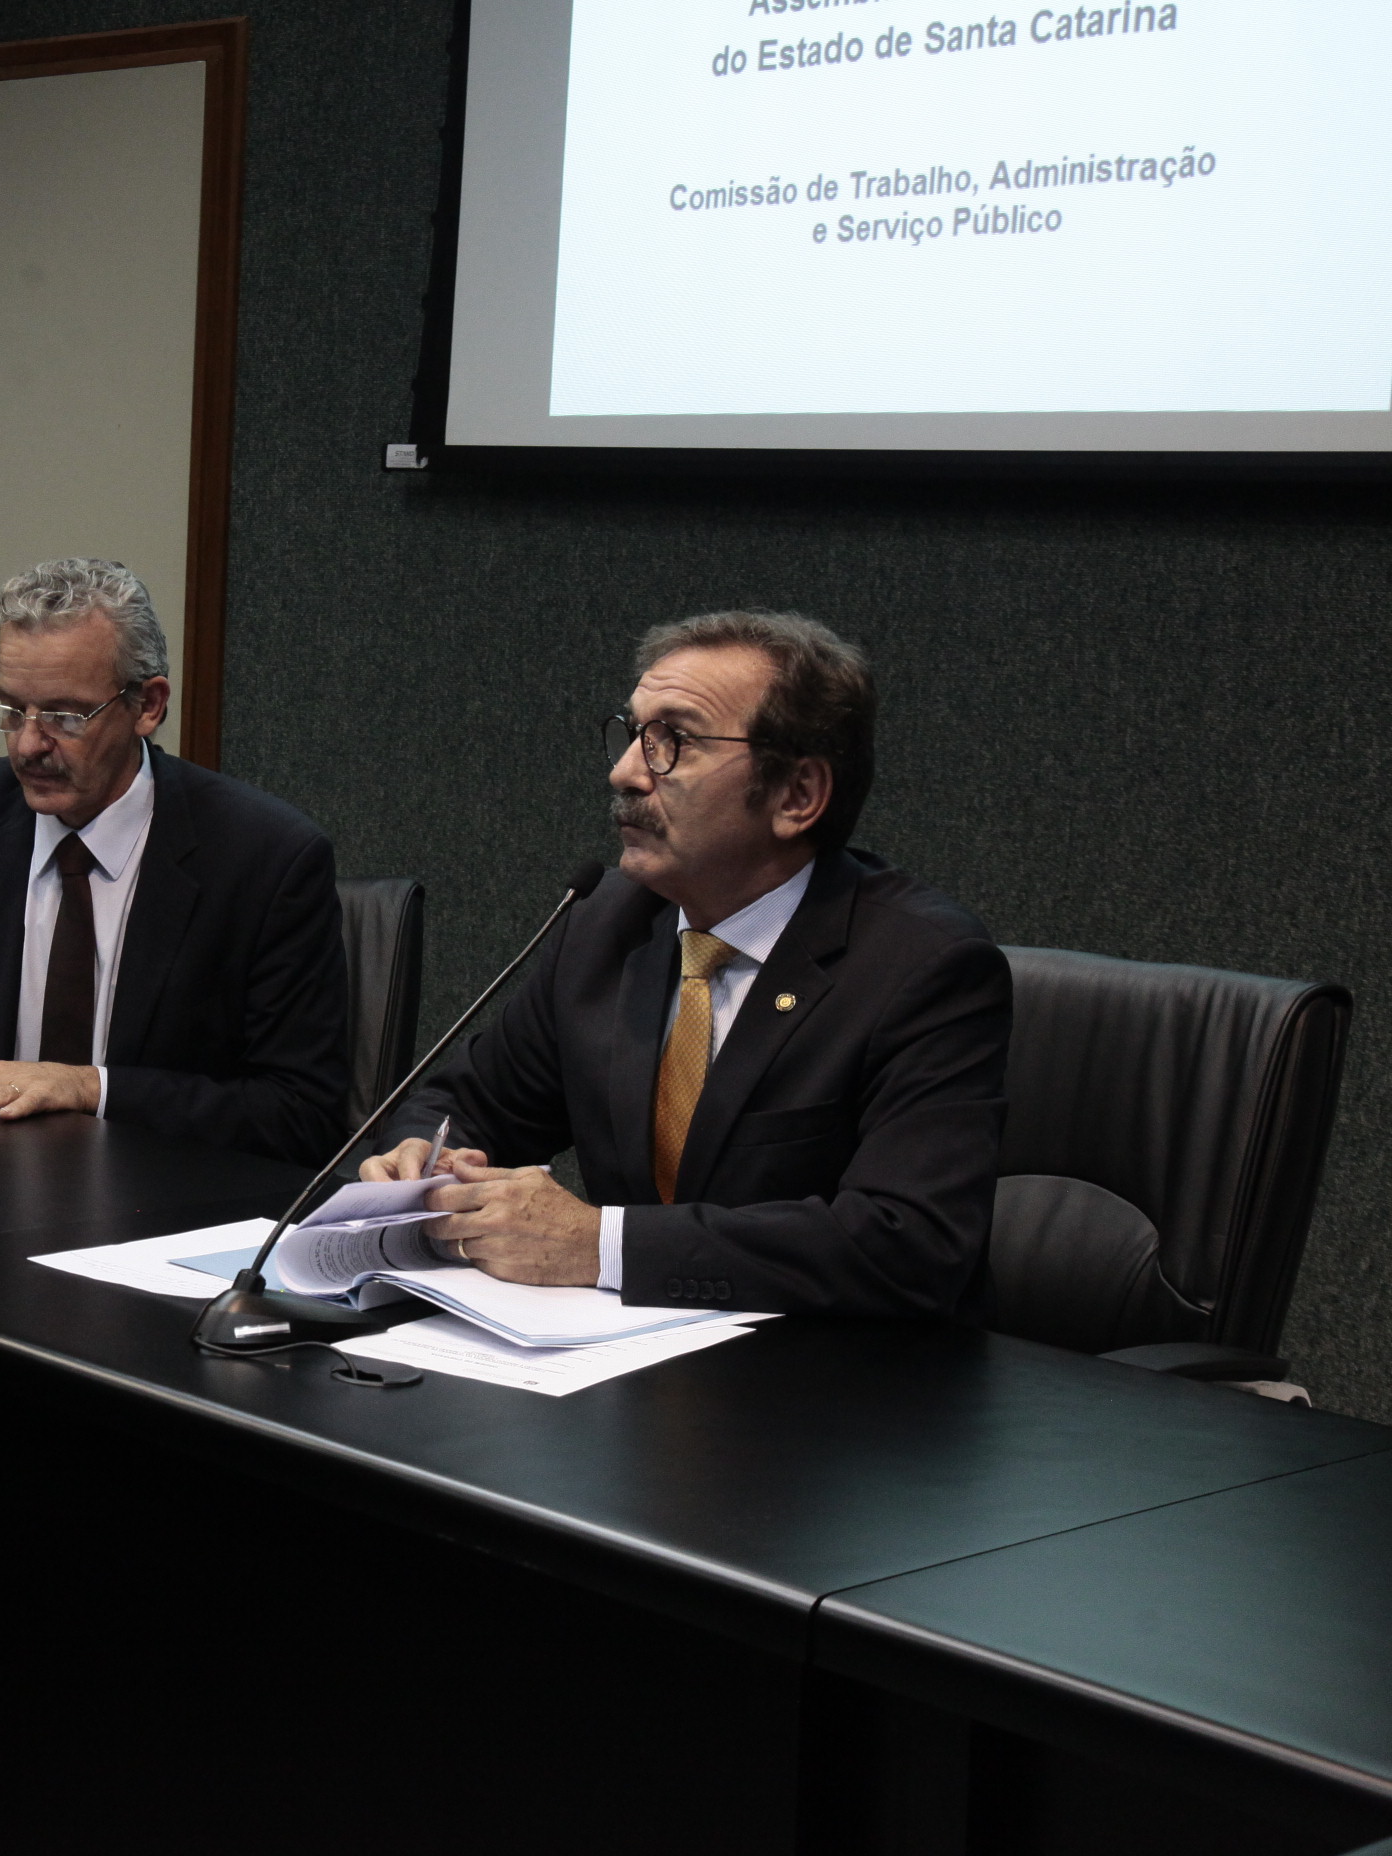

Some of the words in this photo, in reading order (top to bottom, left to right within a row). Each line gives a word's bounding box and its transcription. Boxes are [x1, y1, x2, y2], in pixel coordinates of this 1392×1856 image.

[711, 44, 747, 77] do
[757, 31, 864, 72] Estado
[874, 26, 912, 59] de
[924, 15, 1017, 55] Santa
[1030, 0, 1178, 44] Catarina
[669, 175, 798, 211] Comissão
[806, 173, 839, 202] de
[850, 165, 979, 200] Trabalho,
[988, 145, 1216, 190] Administração
[812, 222, 828, 244] e
[837, 214, 943, 247] Serviço
[952, 204, 1063, 237] Público
